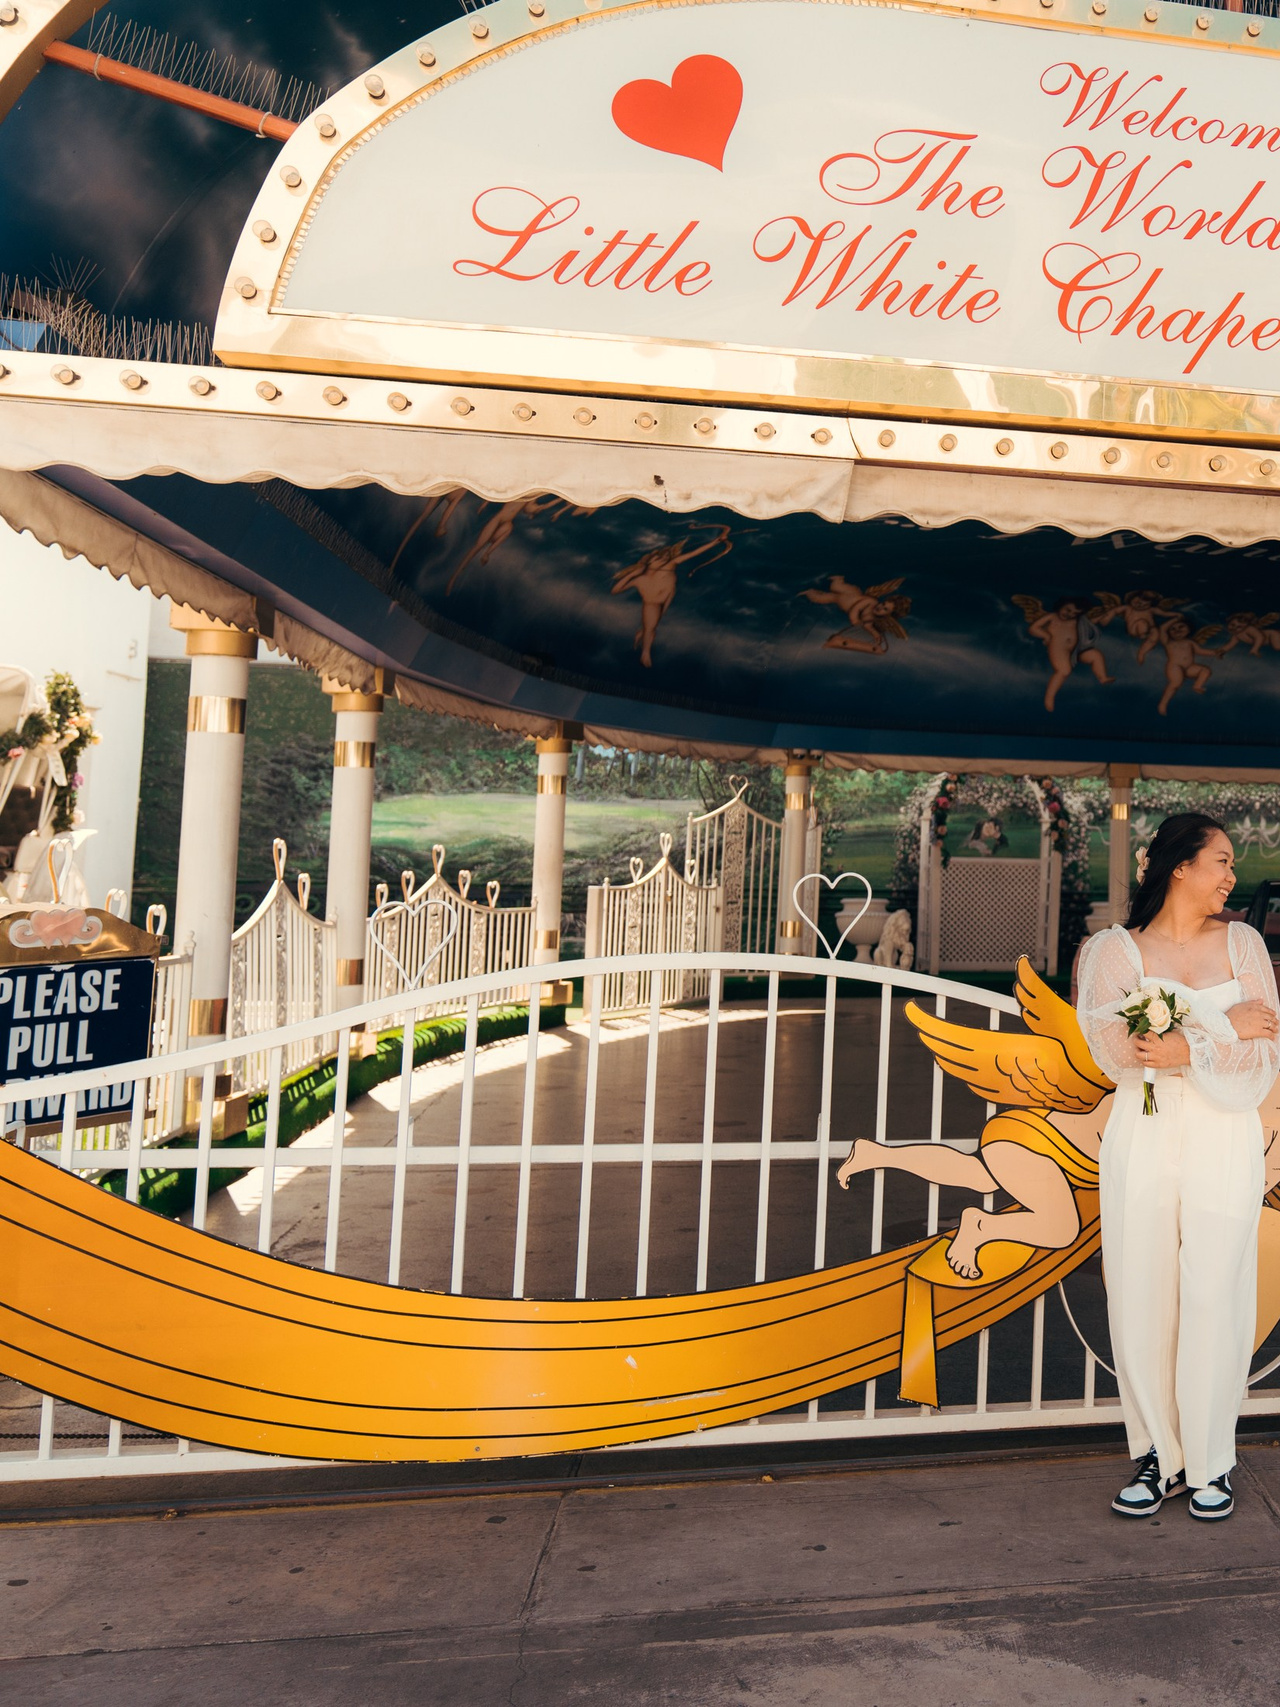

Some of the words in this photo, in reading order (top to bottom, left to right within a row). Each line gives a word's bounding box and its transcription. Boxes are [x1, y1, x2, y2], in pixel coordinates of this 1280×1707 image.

[818, 128, 1006, 219] The
[452, 185, 713, 297] Little
[752, 215, 1001, 324] White
[6, 1019, 93, 1071] PULL
